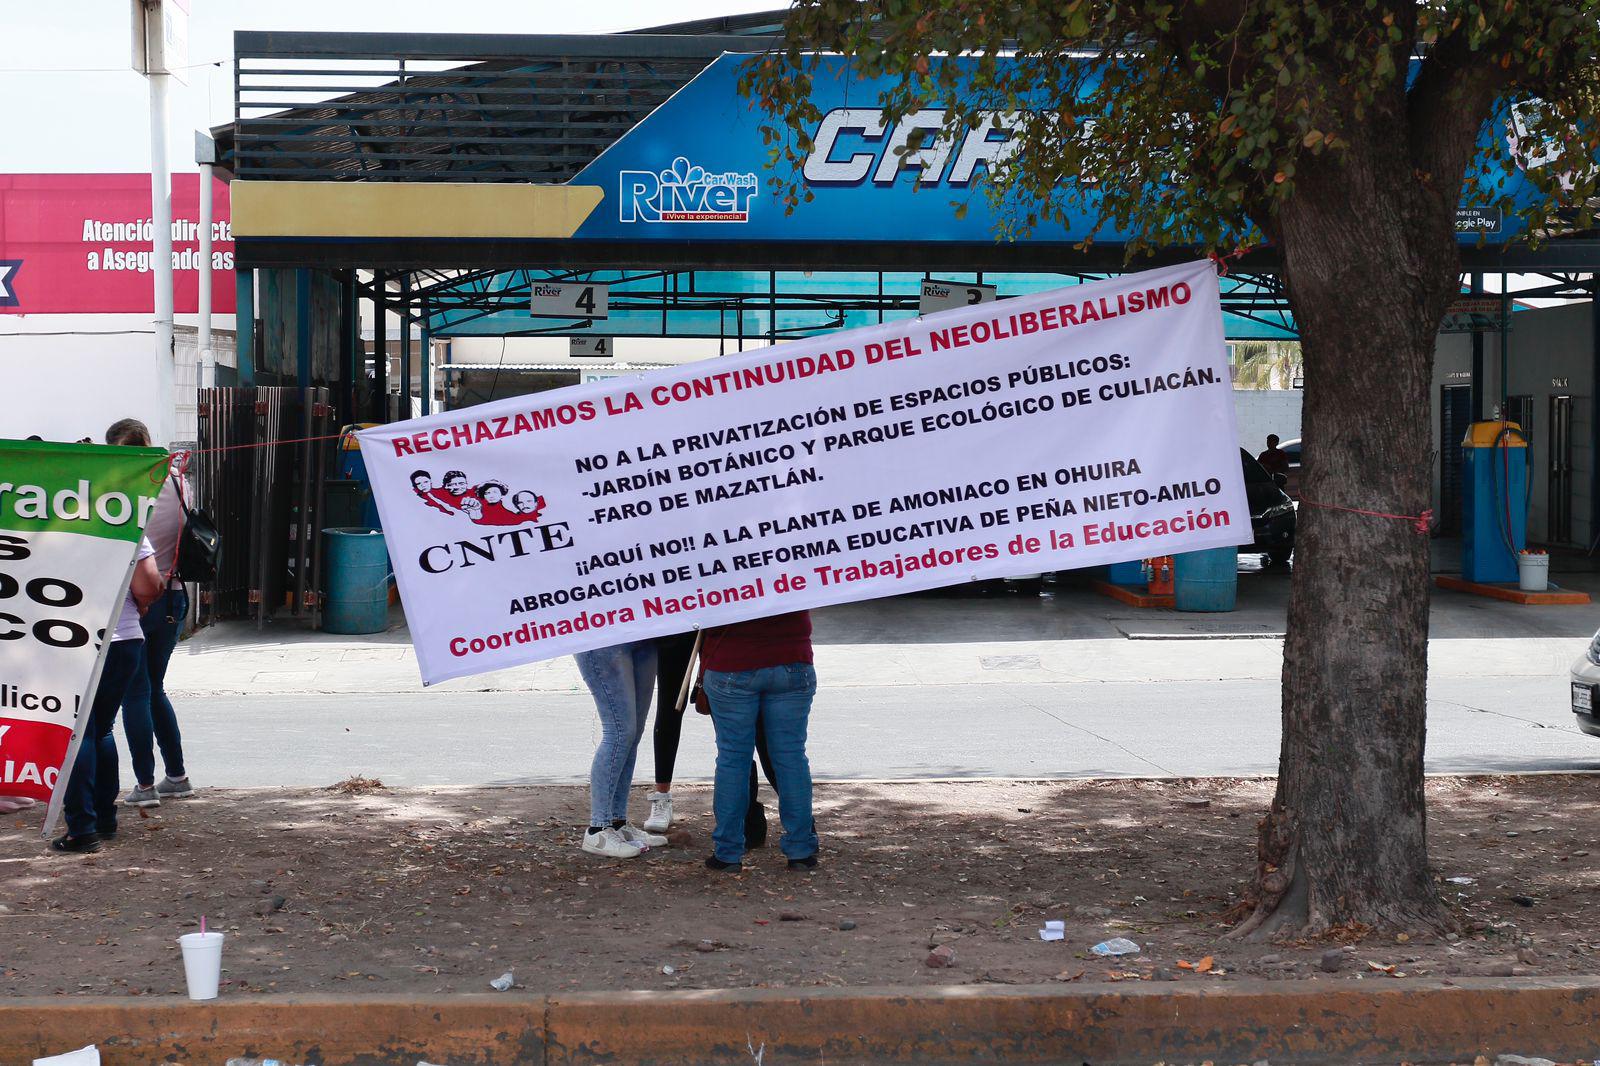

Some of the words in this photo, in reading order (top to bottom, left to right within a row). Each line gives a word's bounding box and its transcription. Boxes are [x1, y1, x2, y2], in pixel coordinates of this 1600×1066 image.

[620, 171, 758, 222] River
[704, 173, 725, 185] Car
[725, 172, 757, 185] Wash
[82, 217, 154, 242] Atenció
[695, 213, 743, 221] experiencia!
[1477, 217, 1496, 230] Play
[87, 251, 99, 270] a
[534, 286, 561, 297] River
[575, 287, 596, 314] 4
[924, 285, 950, 298] River
[391, 400, 596, 457] RECHAZAMOS
[604, 391, 644, 416] LA
[651, 348, 855, 406] CONTINUIDAD
[864, 336, 922, 365] DEL
[929, 281, 1192, 352] NEOLIBERALISMO
[594, 338, 606, 354] 4
[575, 453, 608, 474] NO
[616, 450, 632, 466] A
[636, 442, 667, 462] LA
[672, 405, 847, 455] PRIVATIZACIÓN
[853, 398, 884, 419] DE
[891, 375, 1001, 411] ESPACIOS
[1008, 353, 1131, 388] PÚBLICOS:
[582, 467, 673, 498] -JARDÍN
[677, 444, 795, 481] BOTÁNICO
[801, 439, 817, 456] Y
[824, 420, 915, 452] PARQUE
[921, 394, 1054, 433] ECOLÓGICO
[1061, 388, 1092, 408] DE
[1099, 366, 1222, 402] CULIACÁN.
[576, 543, 643, 577] ¡¡AQUÍ
[649, 536, 696, 559] NO!!
[702, 532, 718, 548] A
[723, 525, 753, 544] LA
[758, 508, 847, 538] PLANTA
[852, 501, 882, 520] DE
[889, 478, 1010, 514] AMONIACO
[1016, 472, 1048, 492] EN
[1054, 458, 1141, 486] OHUIRA
[588, 500, 652, 525] -FARO
[660, 492, 690, 512] DE
[695, 466, 824, 505] MAZATLÁN.
[418, 521, 575, 574] CNTE
[509, 571, 656, 615] ABROGACIÓN
[662, 565, 692, 584] DE
[698, 559, 727, 578] LA
[732, 538, 841, 571] REFORMA
[847, 515, 975, 551] EDUCATIVA
[980, 508, 1010, 528] DE
[1016, 497, 1078, 523] PEÑA
[1083, 477, 1221, 514] NIETO-AMLO
[449, 606, 635, 657] Coordinadora
[642, 578, 765, 618] Nacional
[773, 572, 807, 594] de
[813, 542, 1000, 586] Trabajadores
[1007, 534, 1041, 556] de
[1050, 529, 1074, 550] la
[1082, 506, 1231, 546] Educación
